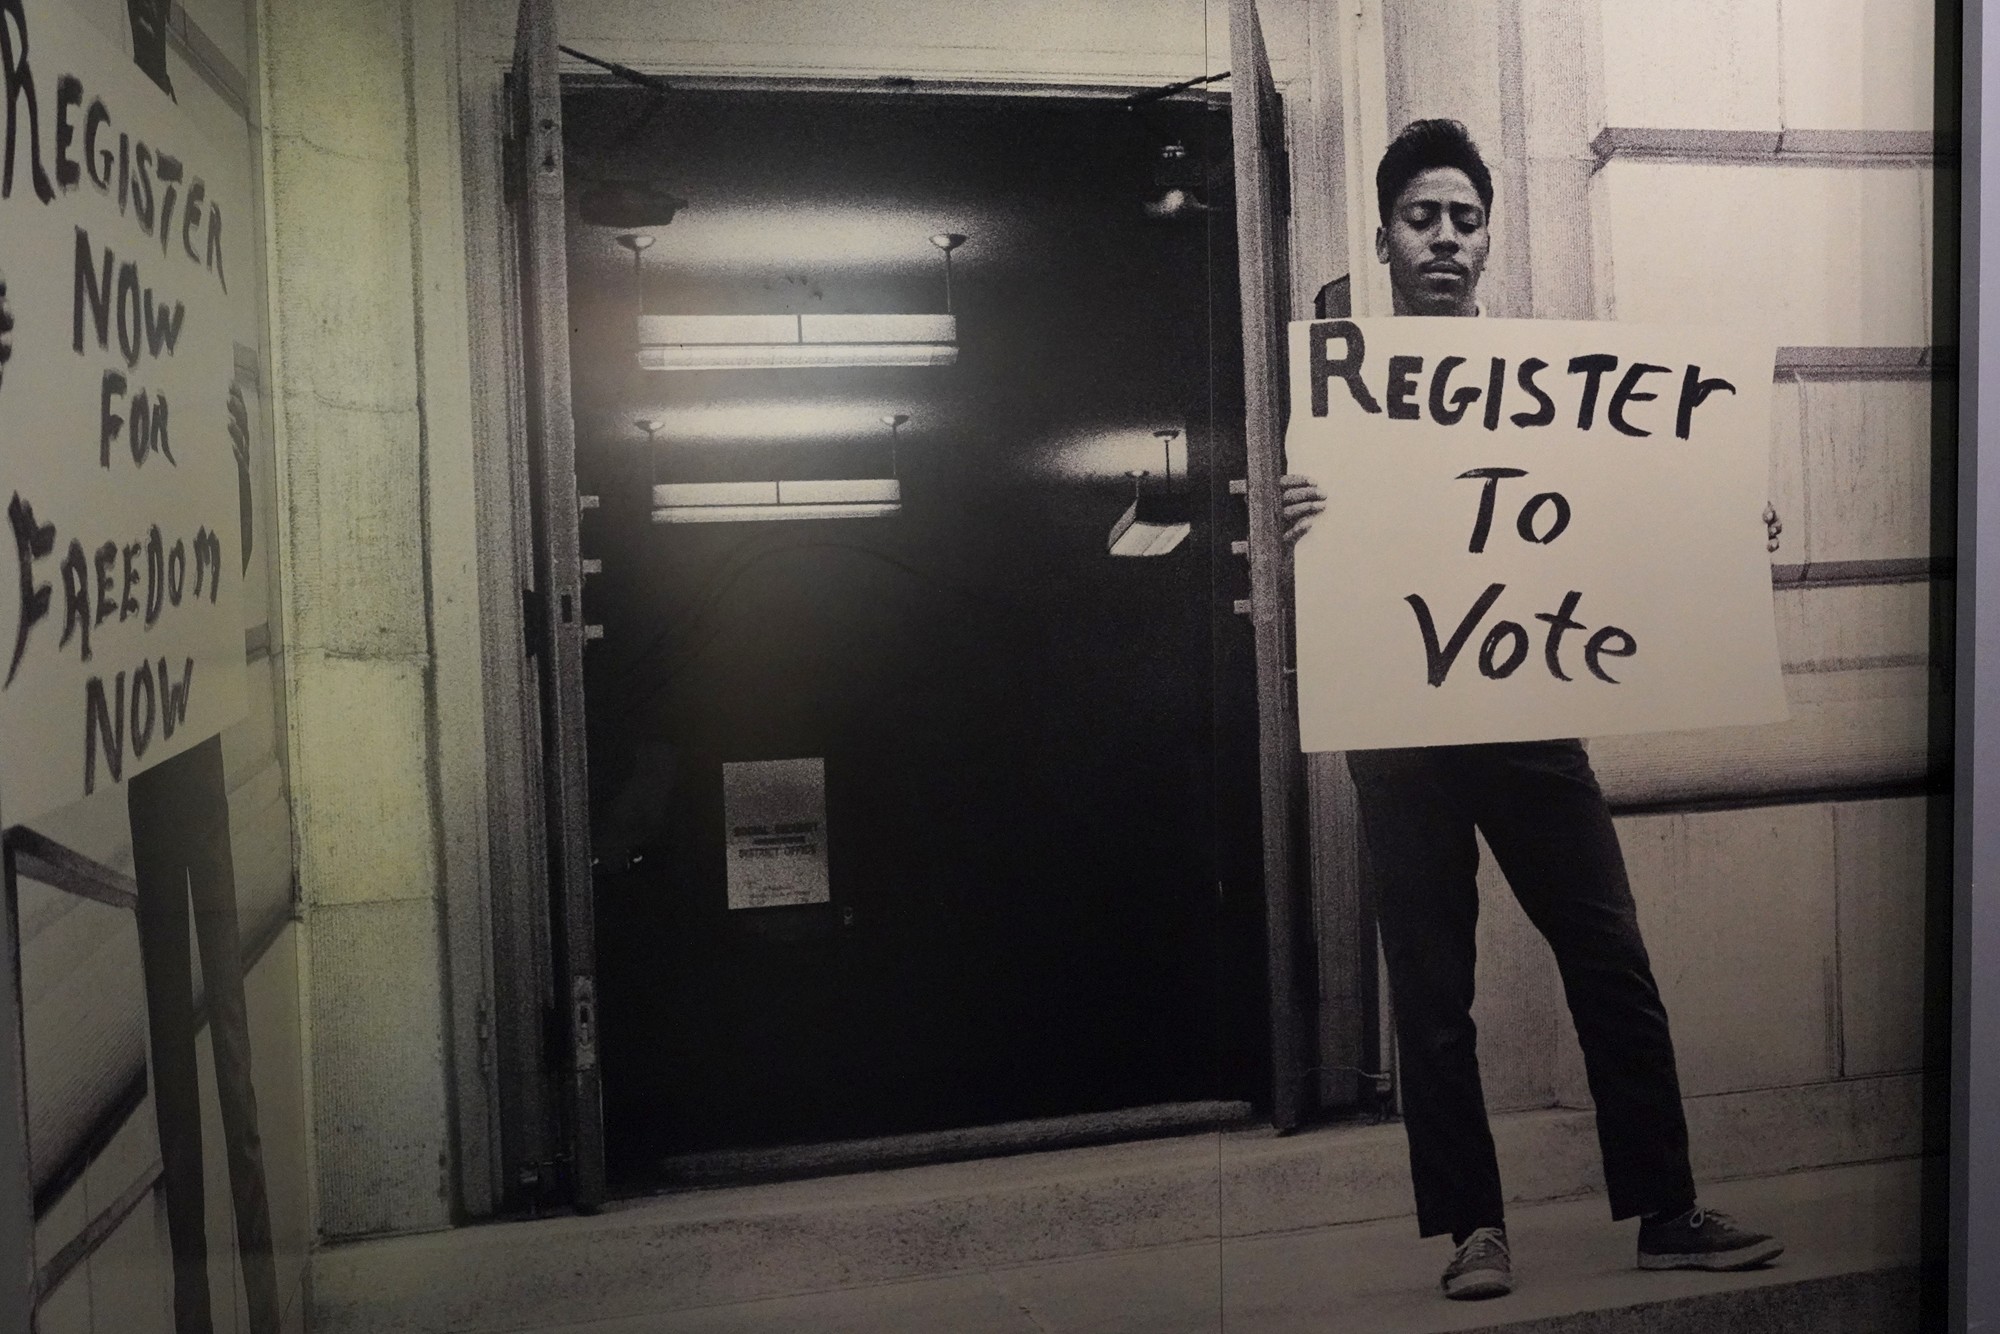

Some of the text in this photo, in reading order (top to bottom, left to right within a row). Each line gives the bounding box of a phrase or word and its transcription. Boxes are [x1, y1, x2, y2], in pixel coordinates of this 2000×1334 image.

[1, 0, 228, 296] REGISTER
[74, 226, 185, 369] NOW
[101, 370, 177, 469] FOR
[5, 490, 222, 691] FREEDOM
[1404, 583, 1638, 689] Vote
[85, 656, 194, 796] NOW
